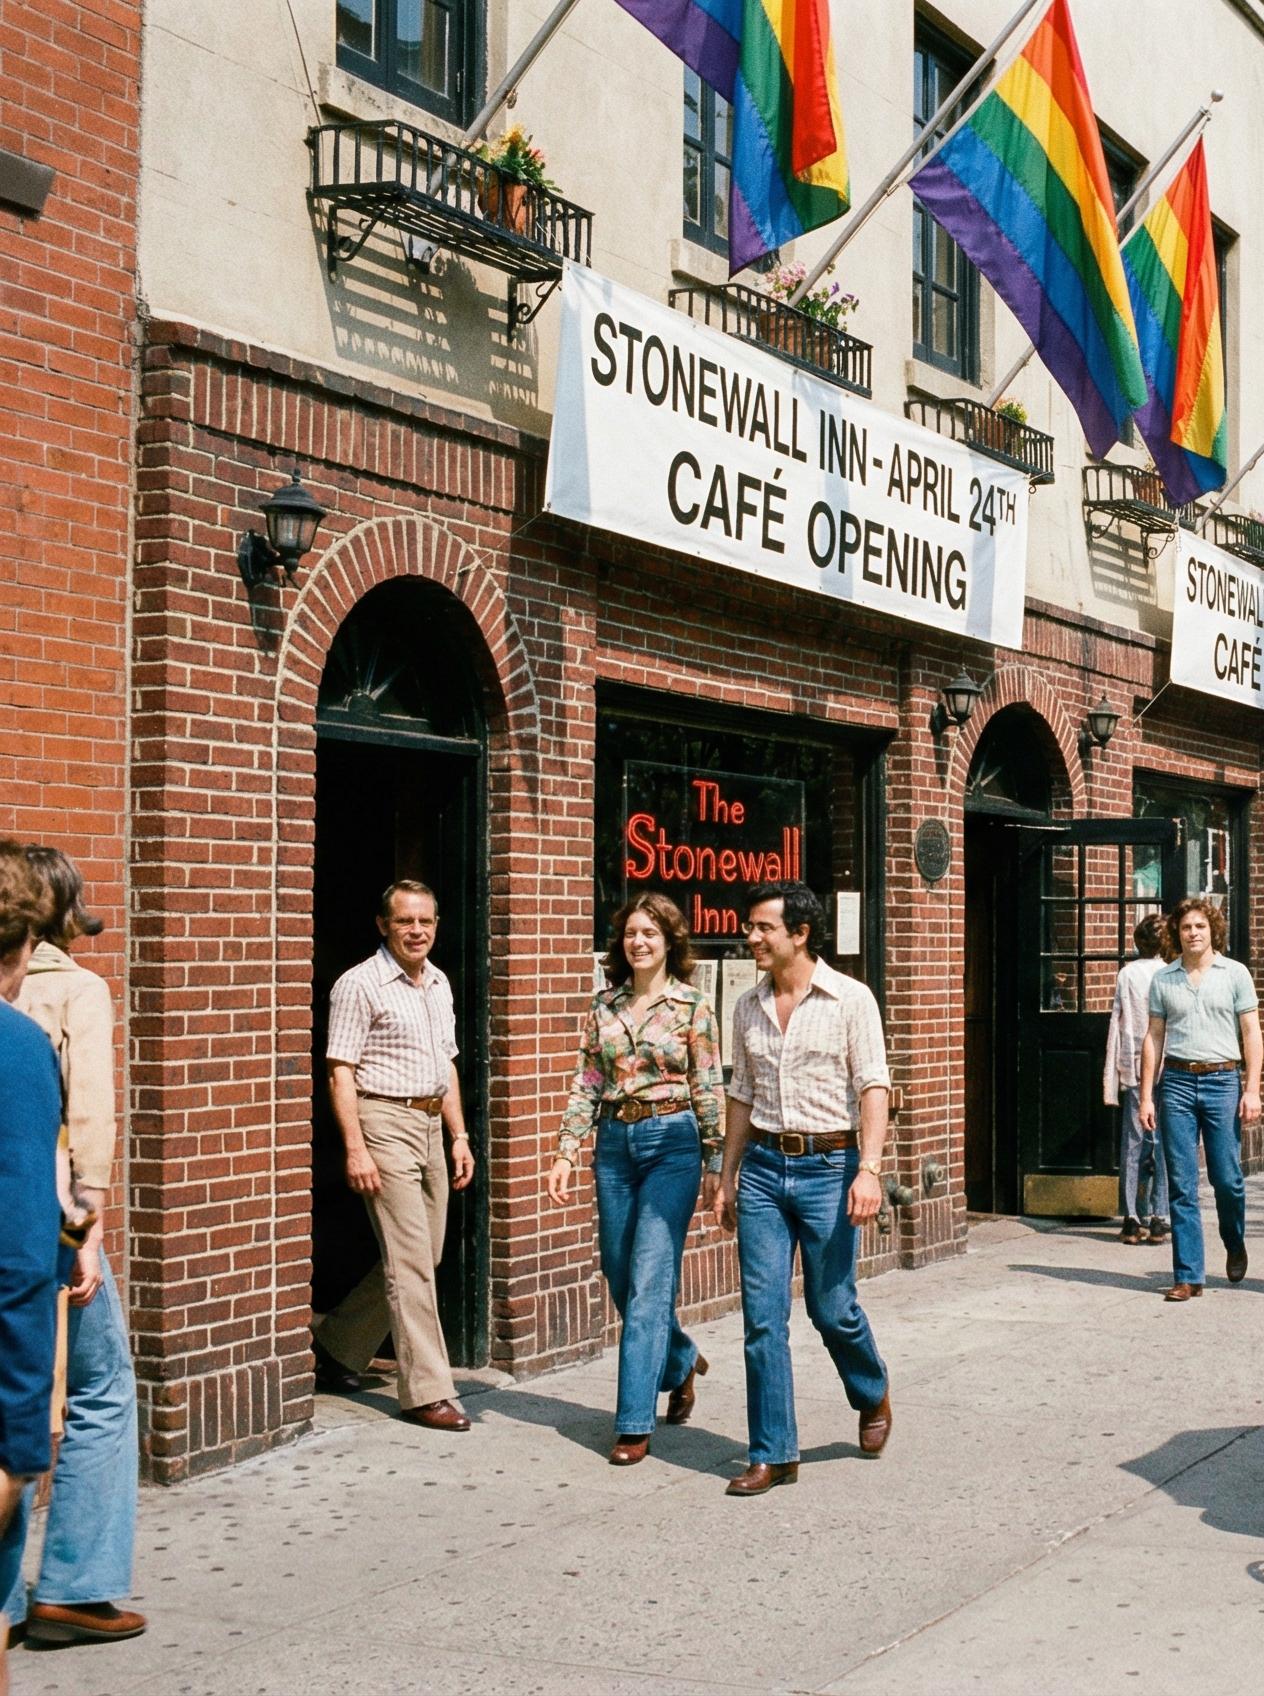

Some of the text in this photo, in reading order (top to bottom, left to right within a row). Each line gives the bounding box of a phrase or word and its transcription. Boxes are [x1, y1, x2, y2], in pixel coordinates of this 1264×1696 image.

[590, 312, 808, 463] STONEWALL
[968, 476, 1017, 537] 24TH
[667, 450, 967, 611] CAFÉ OPENING
[1214, 632, 1263, 691] CAFÉ
[692, 780, 745, 824] The
[625, 813, 800, 883] Stonewall
[694, 894, 738, 934] Inn
